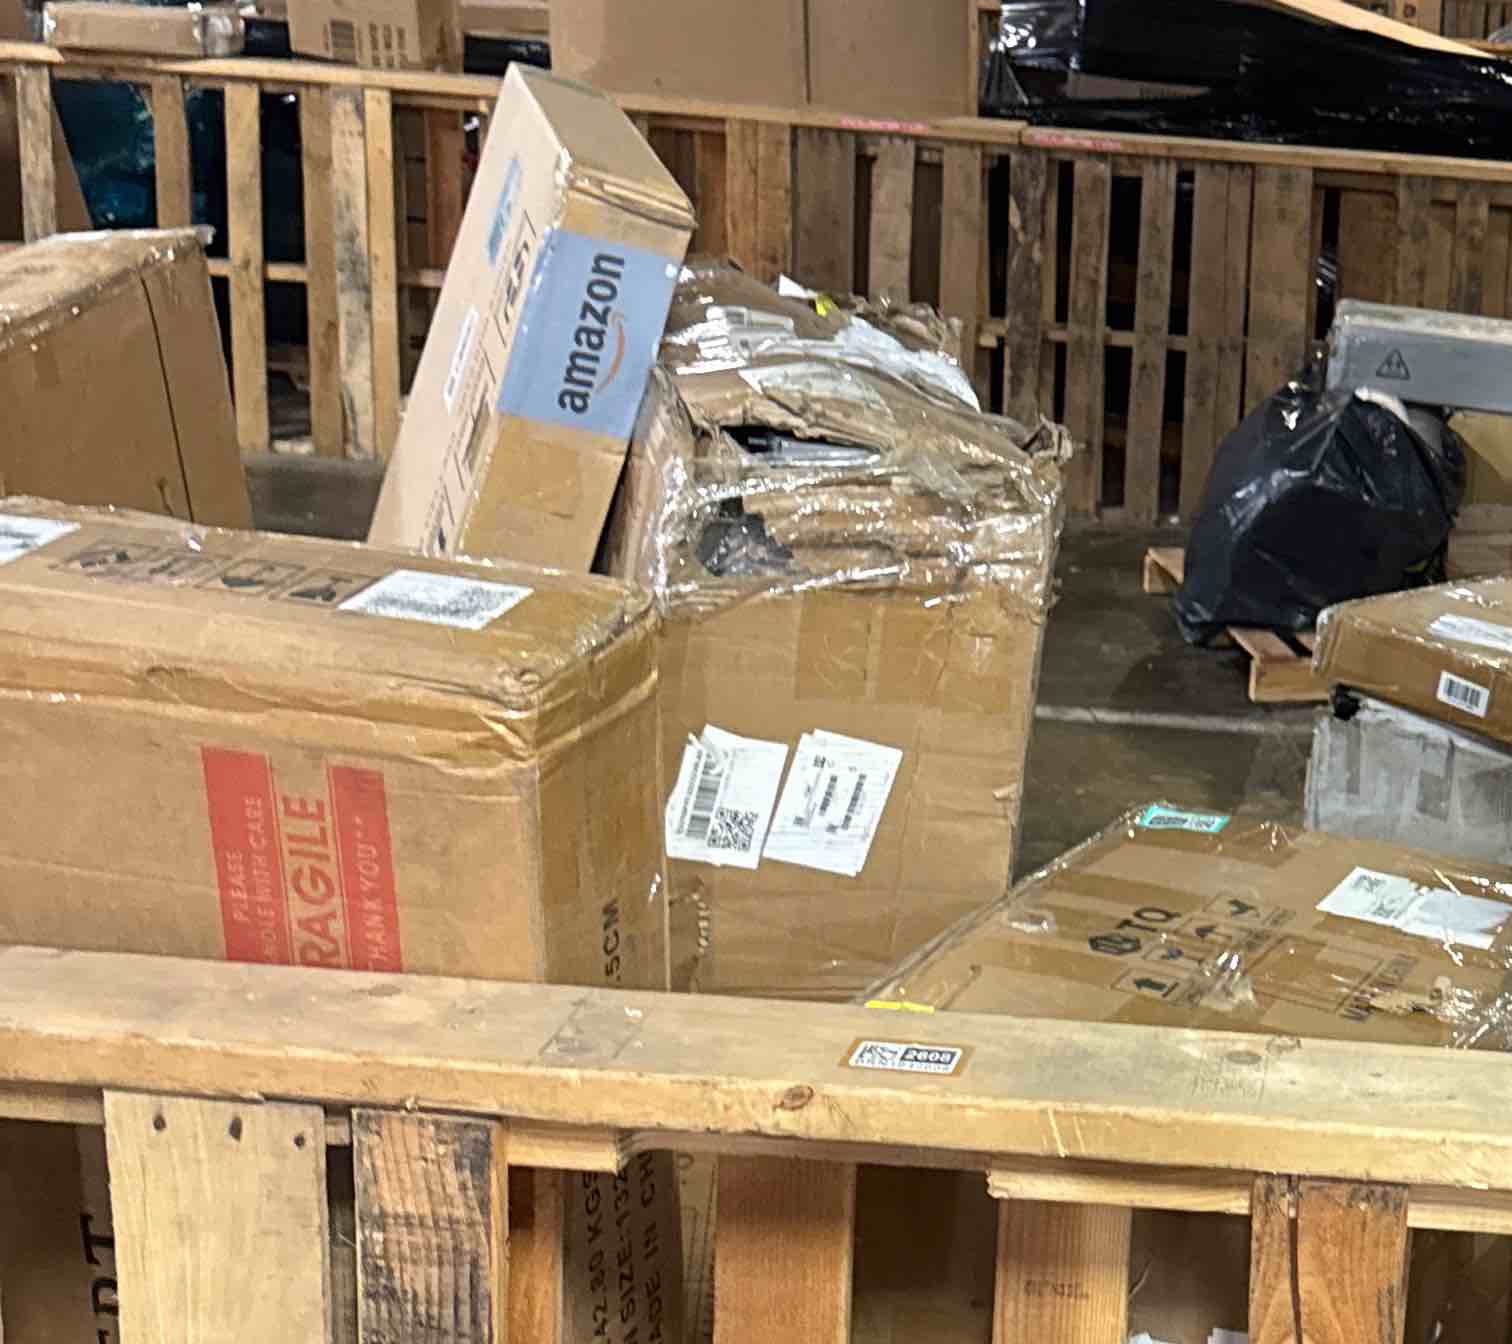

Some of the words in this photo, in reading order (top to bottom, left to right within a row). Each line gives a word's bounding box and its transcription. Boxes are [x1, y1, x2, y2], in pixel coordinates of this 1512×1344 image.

[556, 251, 626, 414] amazon
[245, 795, 268, 849] CARE
[226, 850, 249, 925] PLEASE
[282, 796, 341, 965] RAGILE
[642, 1220, 657, 1261] IN
